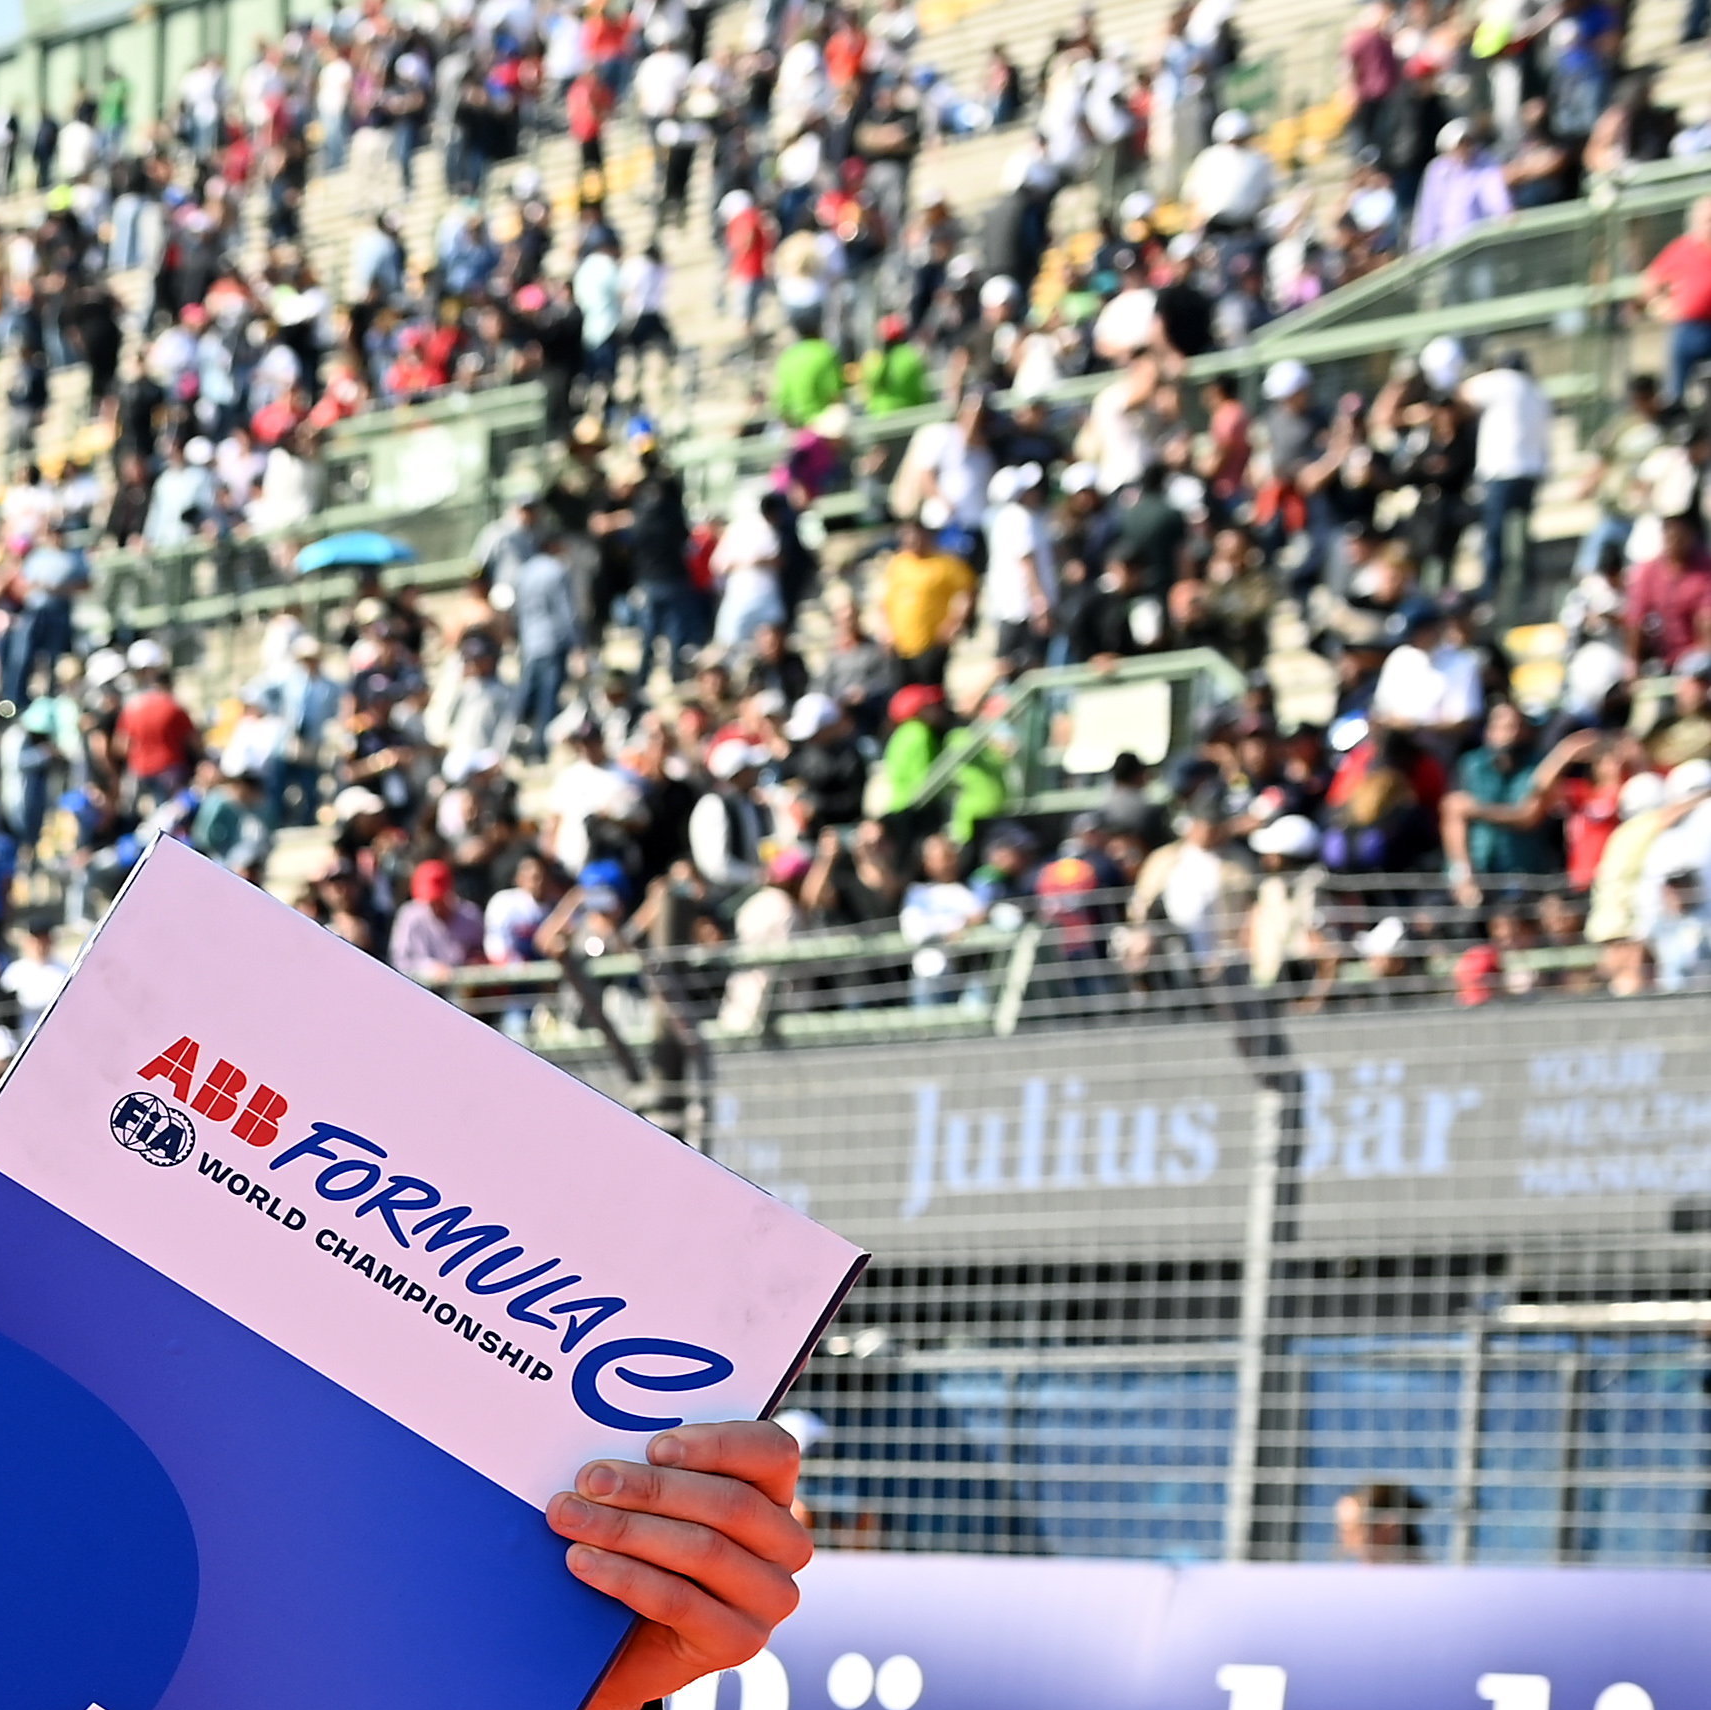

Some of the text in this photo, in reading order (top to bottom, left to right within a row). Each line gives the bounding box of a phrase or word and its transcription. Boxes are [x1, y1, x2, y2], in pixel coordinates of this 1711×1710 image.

[136, 1036, 288, 1148] ABB
[269, 1121, 627, 1354] FORMULA
[197, 1151, 554, 1387] WORLD CHAMPIONSHIP
